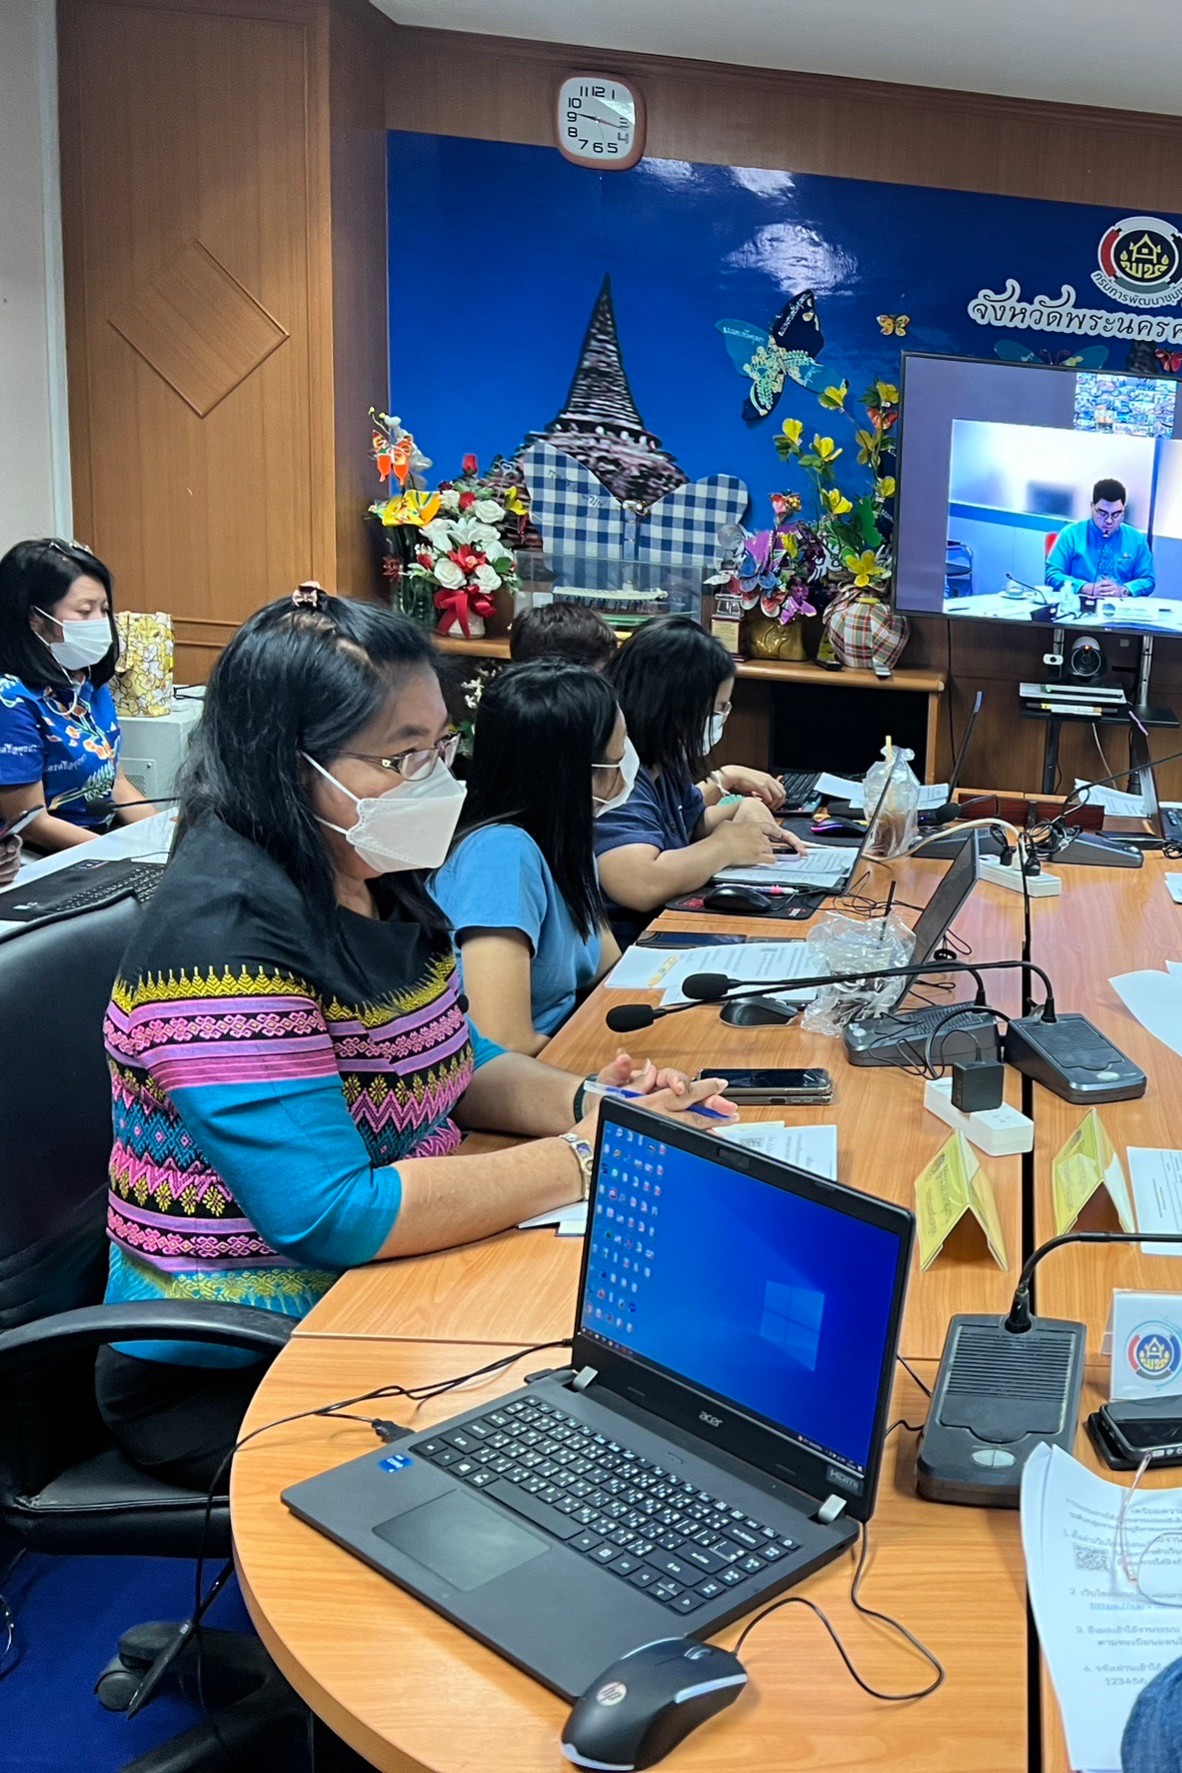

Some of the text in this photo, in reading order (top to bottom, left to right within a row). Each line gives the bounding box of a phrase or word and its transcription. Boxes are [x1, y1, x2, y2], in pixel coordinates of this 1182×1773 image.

[580, 85, 589, 97] 11
[591, 85, 606, 98] 12
[568, 97, 582, 109] 10
[566, 111, 578, 123] 9
[567, 126, 579, 138] 8
[578, 138, 589, 150] 7
[592, 142, 604, 154] 6
[606, 142, 619, 154] 5
